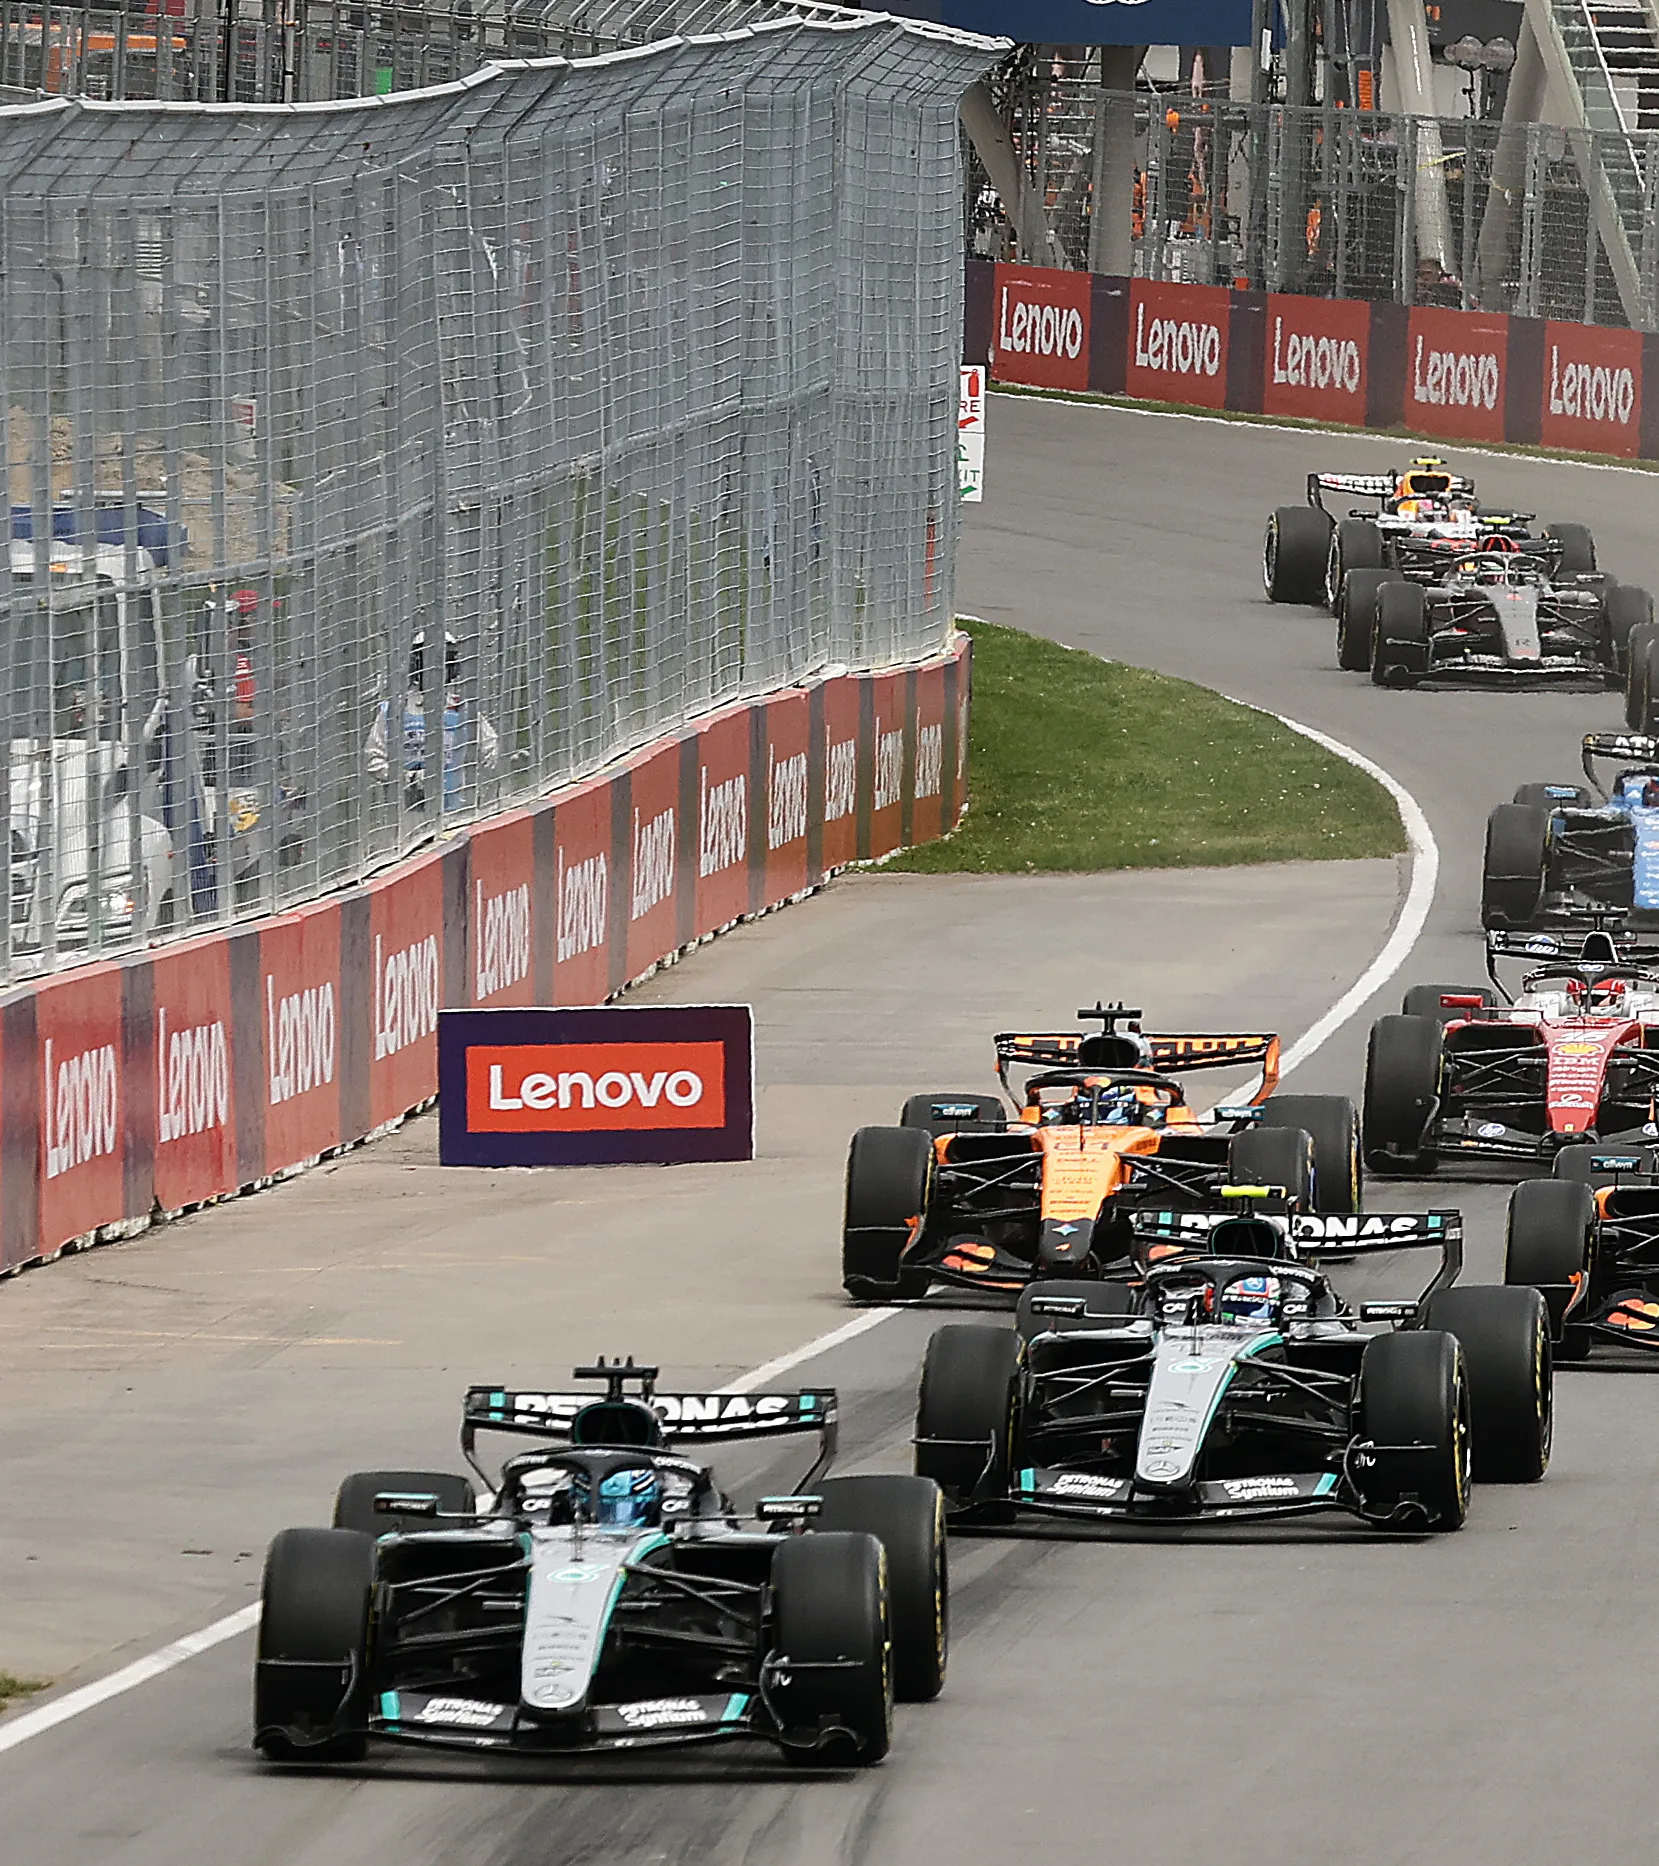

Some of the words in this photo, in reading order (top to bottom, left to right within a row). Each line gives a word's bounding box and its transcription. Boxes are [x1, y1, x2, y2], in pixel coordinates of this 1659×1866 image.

[1000, 285, 1082, 360] Lenovo
[1135, 302, 1221, 377] Lenovo
[1273, 316, 1360, 394] Lenovo
[1413, 335, 1498, 411] Lenovo
[1550, 344, 1633, 424] Lenovo
[960, 470, 980, 482] IT
[824, 725, 855, 822] Lenovo
[875, 716, 903, 810] Lenovo
[914, 706, 942, 798] Lenovo
[700, 765, 746, 877] Lenovo
[769, 743, 806, 850] Lenovo
[632, 807, 674, 921] Lenovo
[477, 878, 529, 1001] Lenovo
[557, 846, 607, 963] Lenovo
[376, 934, 438, 1060] Lenovo
[159, 1007, 229, 1143] Lenovo
[267, 973, 334, 1105] Lenovo
[45, 1039, 117, 1179] Lenovo
[489, 1064, 703, 1110] Lenovo
[1180, 1213, 1418, 1248] PONAS
[514, 1397, 789, 1432] PEONAS
[1047, 1482, 1117, 1498] Syntium
[1057, 1474, 1124, 1489] PETRONAS
[1224, 1477, 1294, 1489] PETRONAS
[1228, 1486, 1299, 1500] Syntium
[414, 1709, 495, 1727] Syntium
[427, 1698, 504, 1717] PETRONAS
[618, 1700, 701, 1716] PETRONAS
[624, 1709, 706, 1727] Syntium
